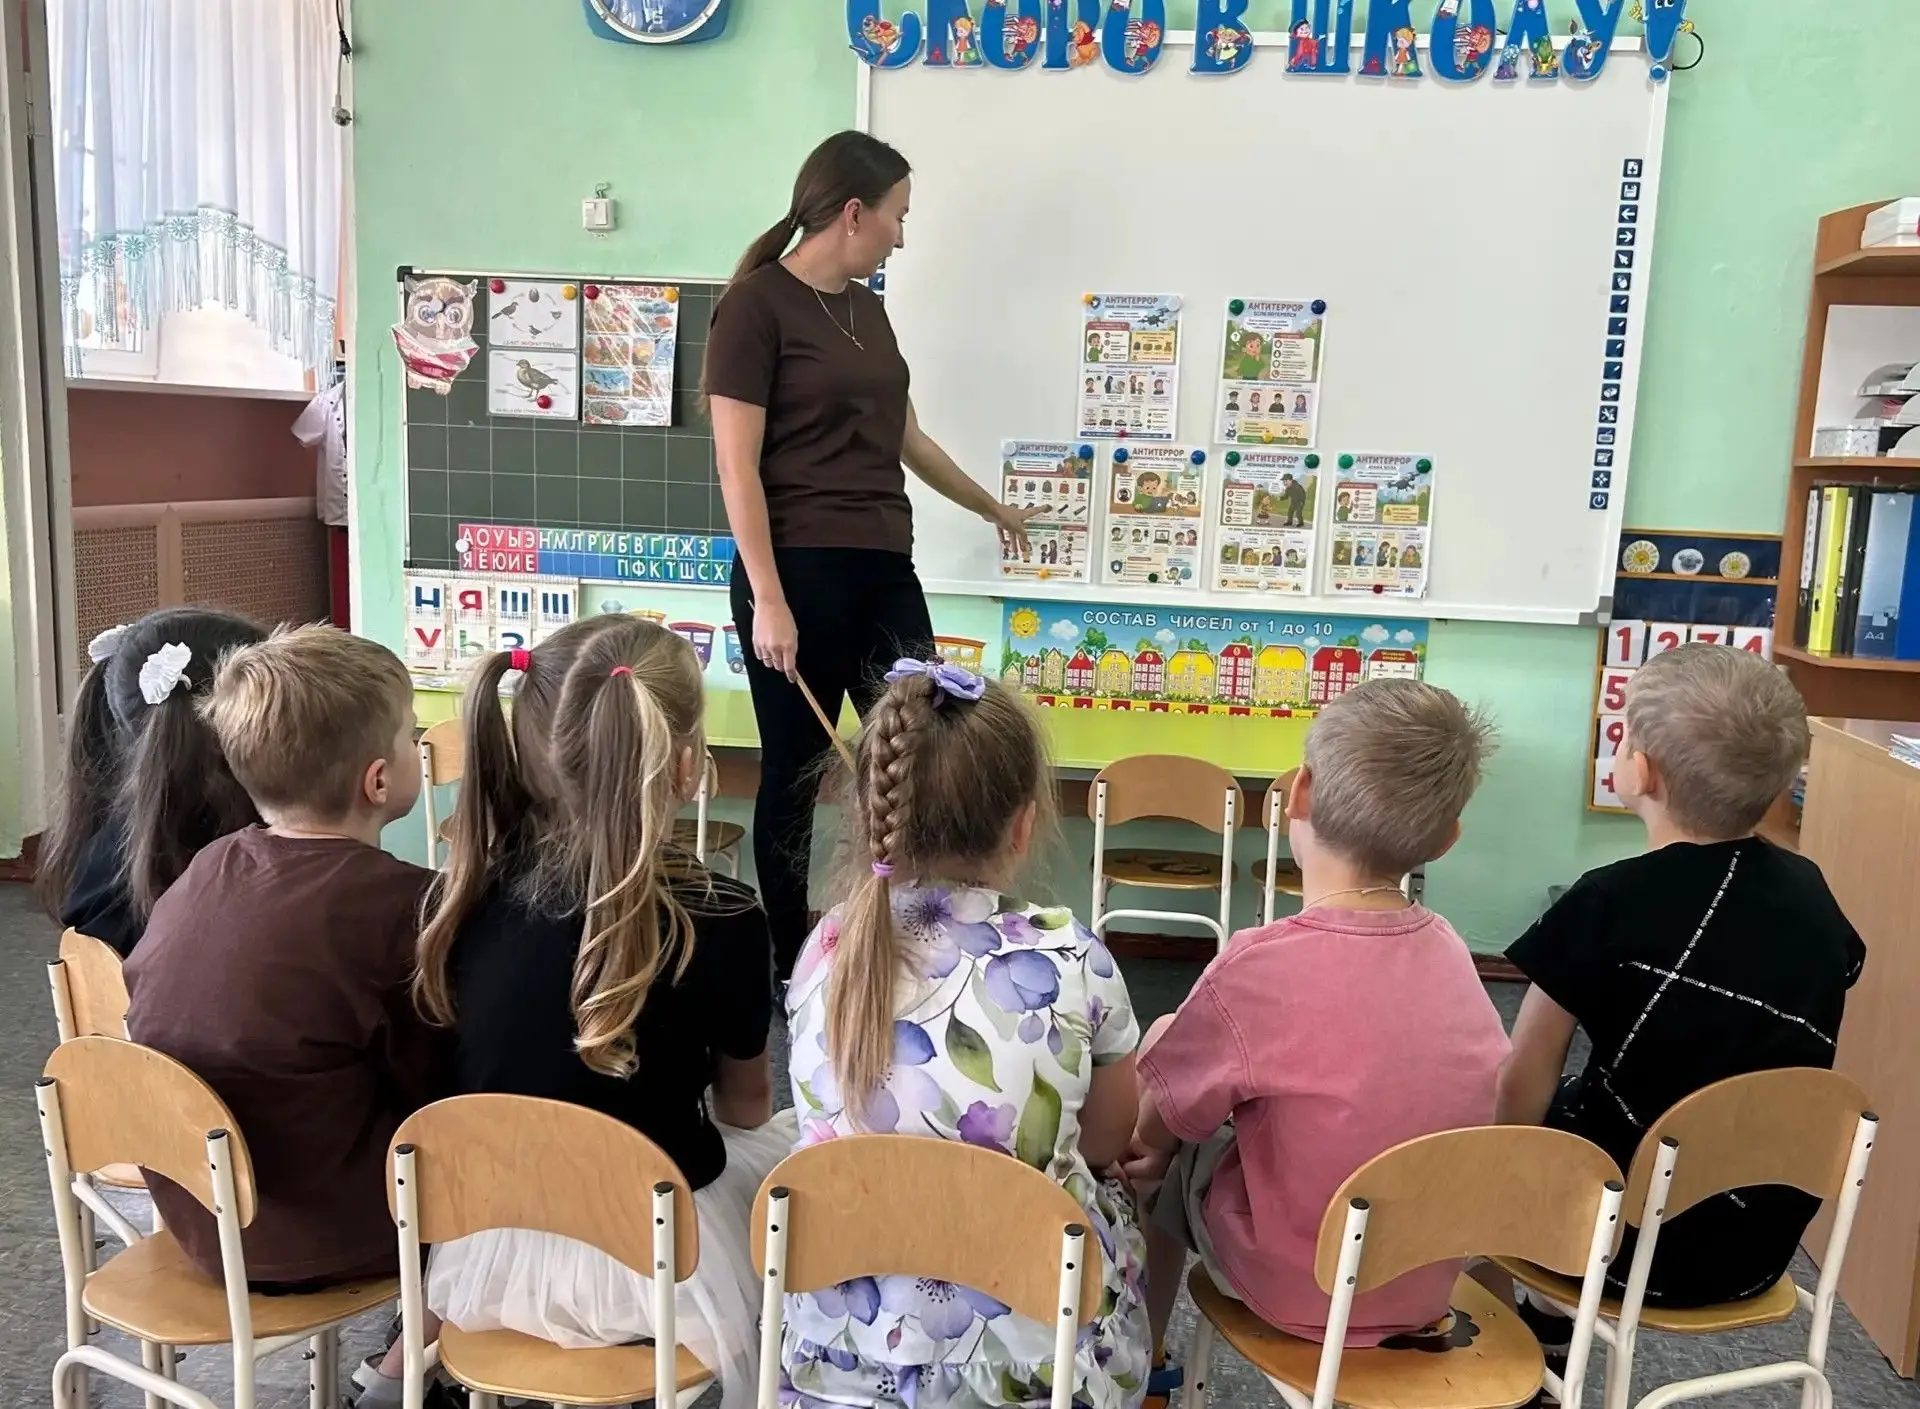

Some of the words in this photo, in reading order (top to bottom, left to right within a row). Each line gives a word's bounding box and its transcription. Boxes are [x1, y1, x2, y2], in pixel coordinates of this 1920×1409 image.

[1104, 295, 1159, 305] АНТИТЕРРОР
[1247, 302, 1304, 312] АНТИТЕРРОР
[1019, 444, 1068, 453] АНТИТЕРРОР
[1132, 447, 1185, 457] АНТИТЕРРОР
[1243, 453, 1300, 464] АНТИТЕРРОР
[1355, 455, 1412, 465] АНТИТЕРРОР
[1082, 610, 1157, 627] СОСТАВ
[1169, 615, 1233, 631] ЧИСЕЛ
[1239, 621, 1259, 633] от
[1267, 620, 1275, 633] 1
[1281, 623, 1305, 636] до
[1313, 622, 1333, 636] 10
[1863, 631, 1885, 641] A4
[1616, 626, 1632, 662] 1
[1604, 675, 1629, 711] 5
[1606, 721, 1624, 756] 9
